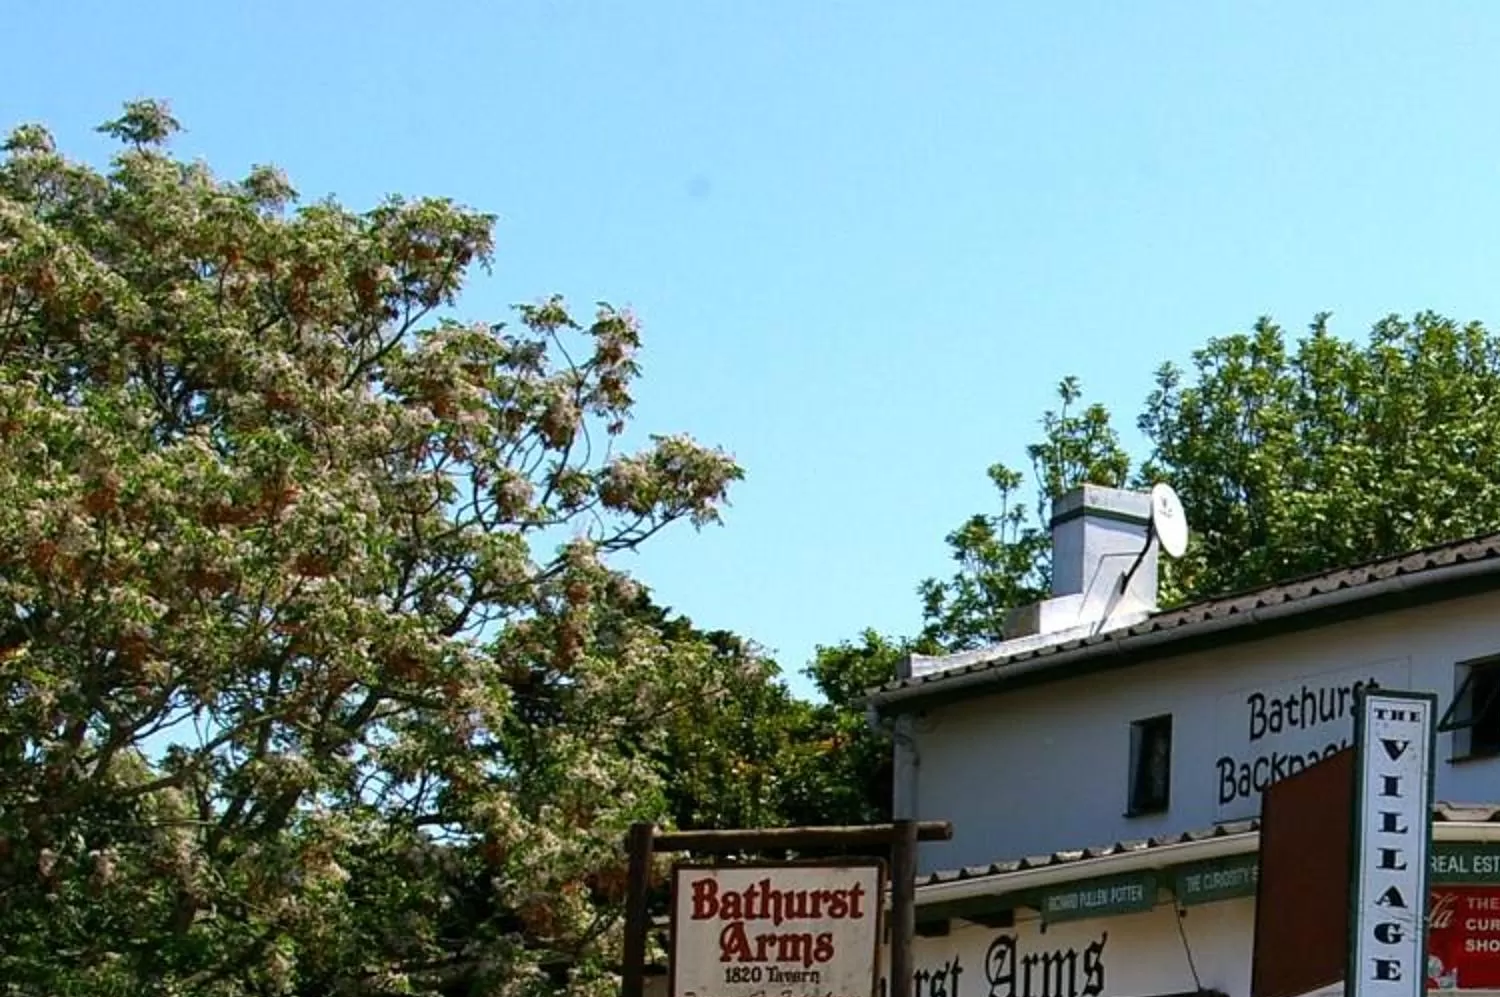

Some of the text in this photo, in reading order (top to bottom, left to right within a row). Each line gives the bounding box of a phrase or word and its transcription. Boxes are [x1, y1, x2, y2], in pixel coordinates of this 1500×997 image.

[1374, 708, 1421, 722] THE
[1371, 738, 1411, 981] VILLAGE
[690, 877, 865, 927] Bathurst
[1467, 897, 1500, 910] THE
[720, 921, 834, 969] Arms
[725, 966, 820, 984] 1820 Tavern
